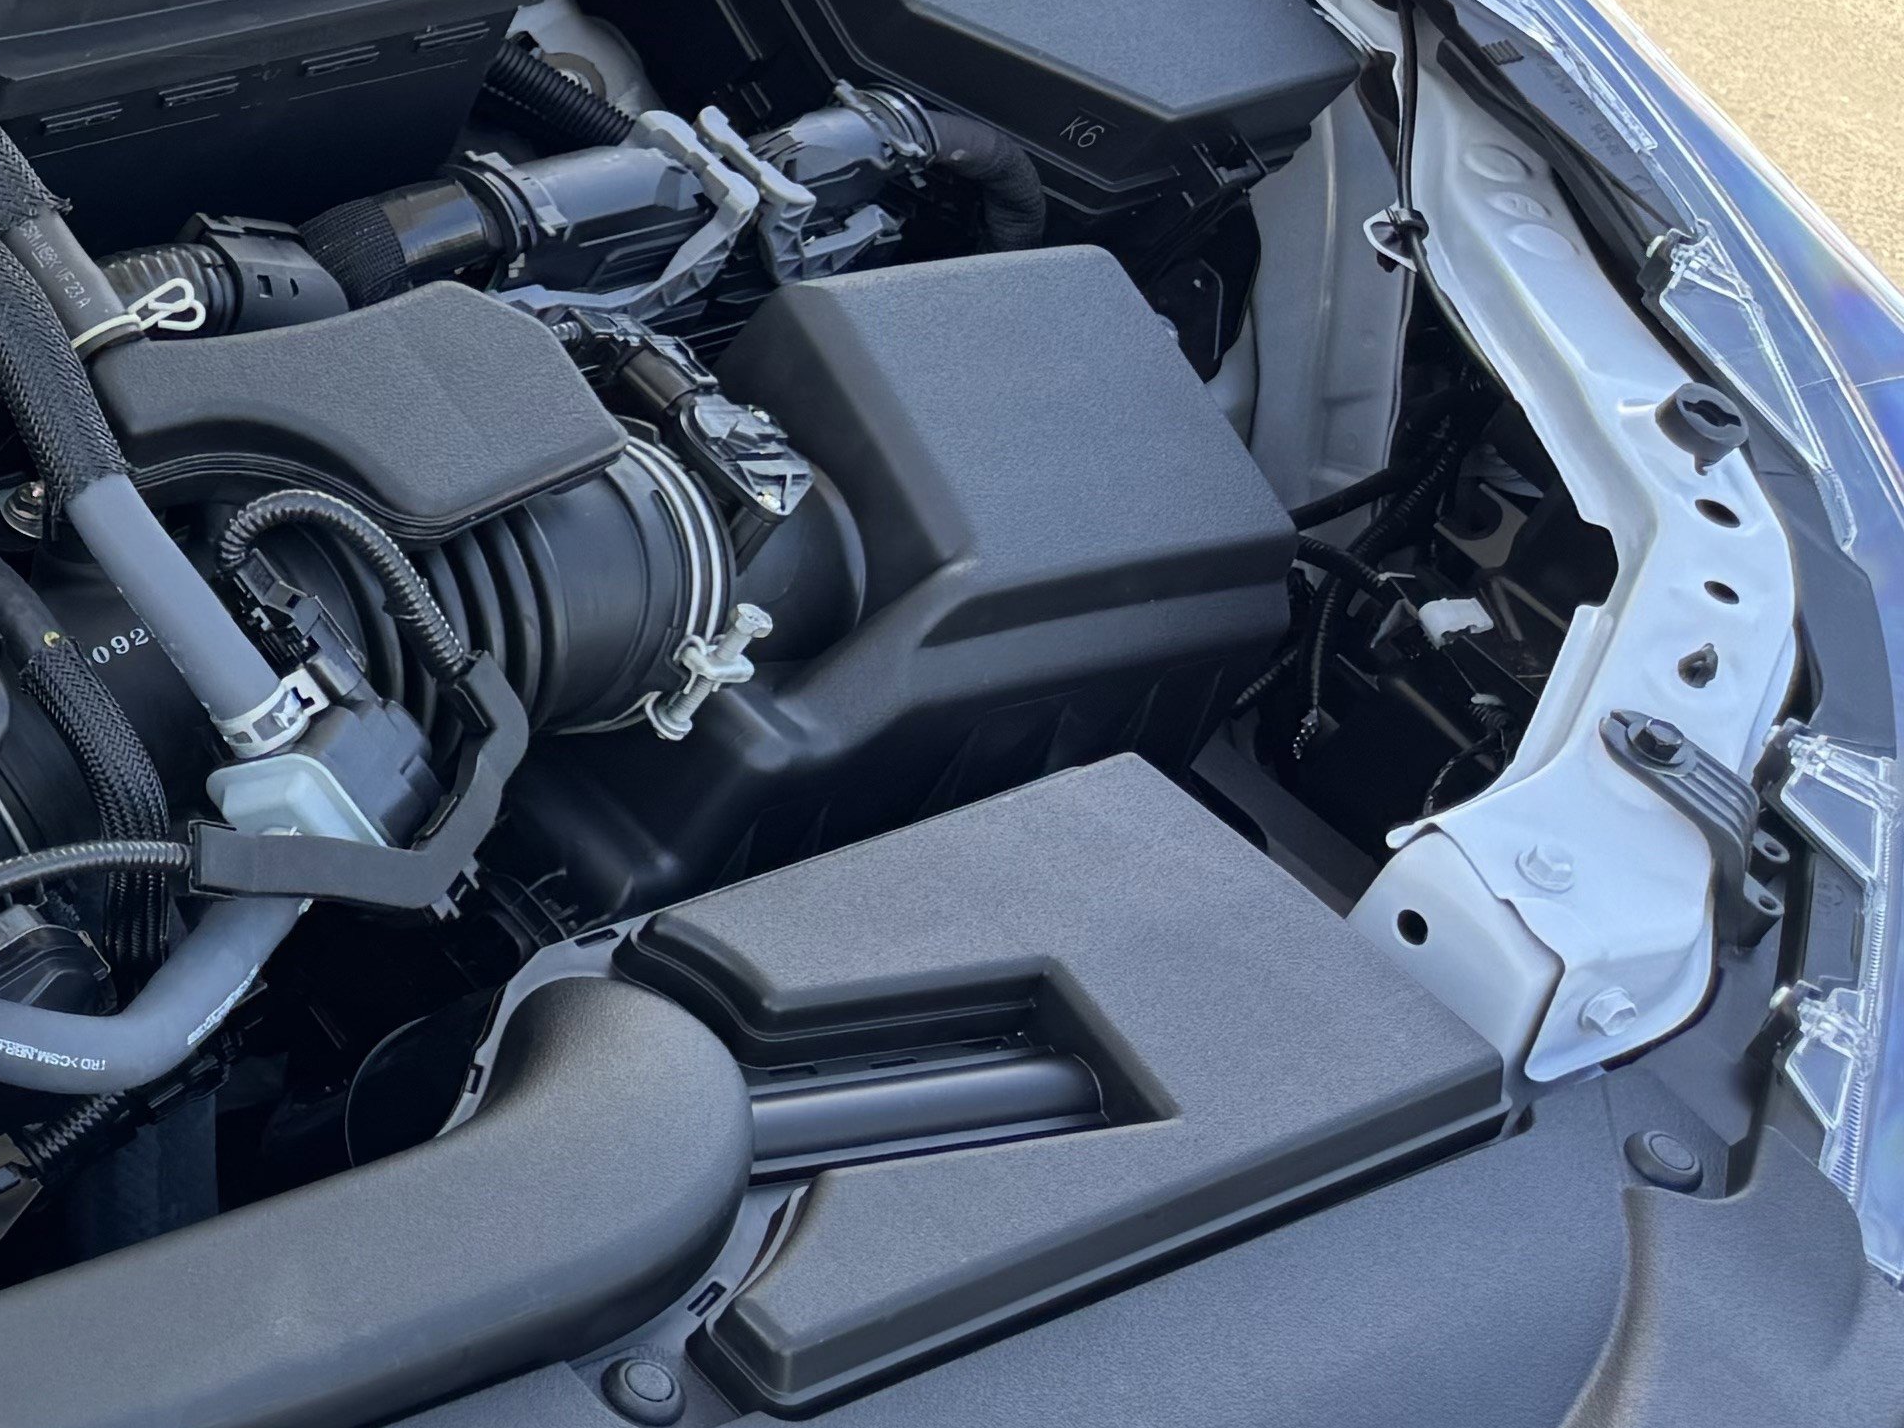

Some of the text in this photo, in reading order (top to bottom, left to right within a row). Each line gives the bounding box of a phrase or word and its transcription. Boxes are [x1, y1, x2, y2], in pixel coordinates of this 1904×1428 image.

[1059, 116, 1106, 149] K6
[74, 294, 92, 310] A
[92, 627, 149, 664] 092
